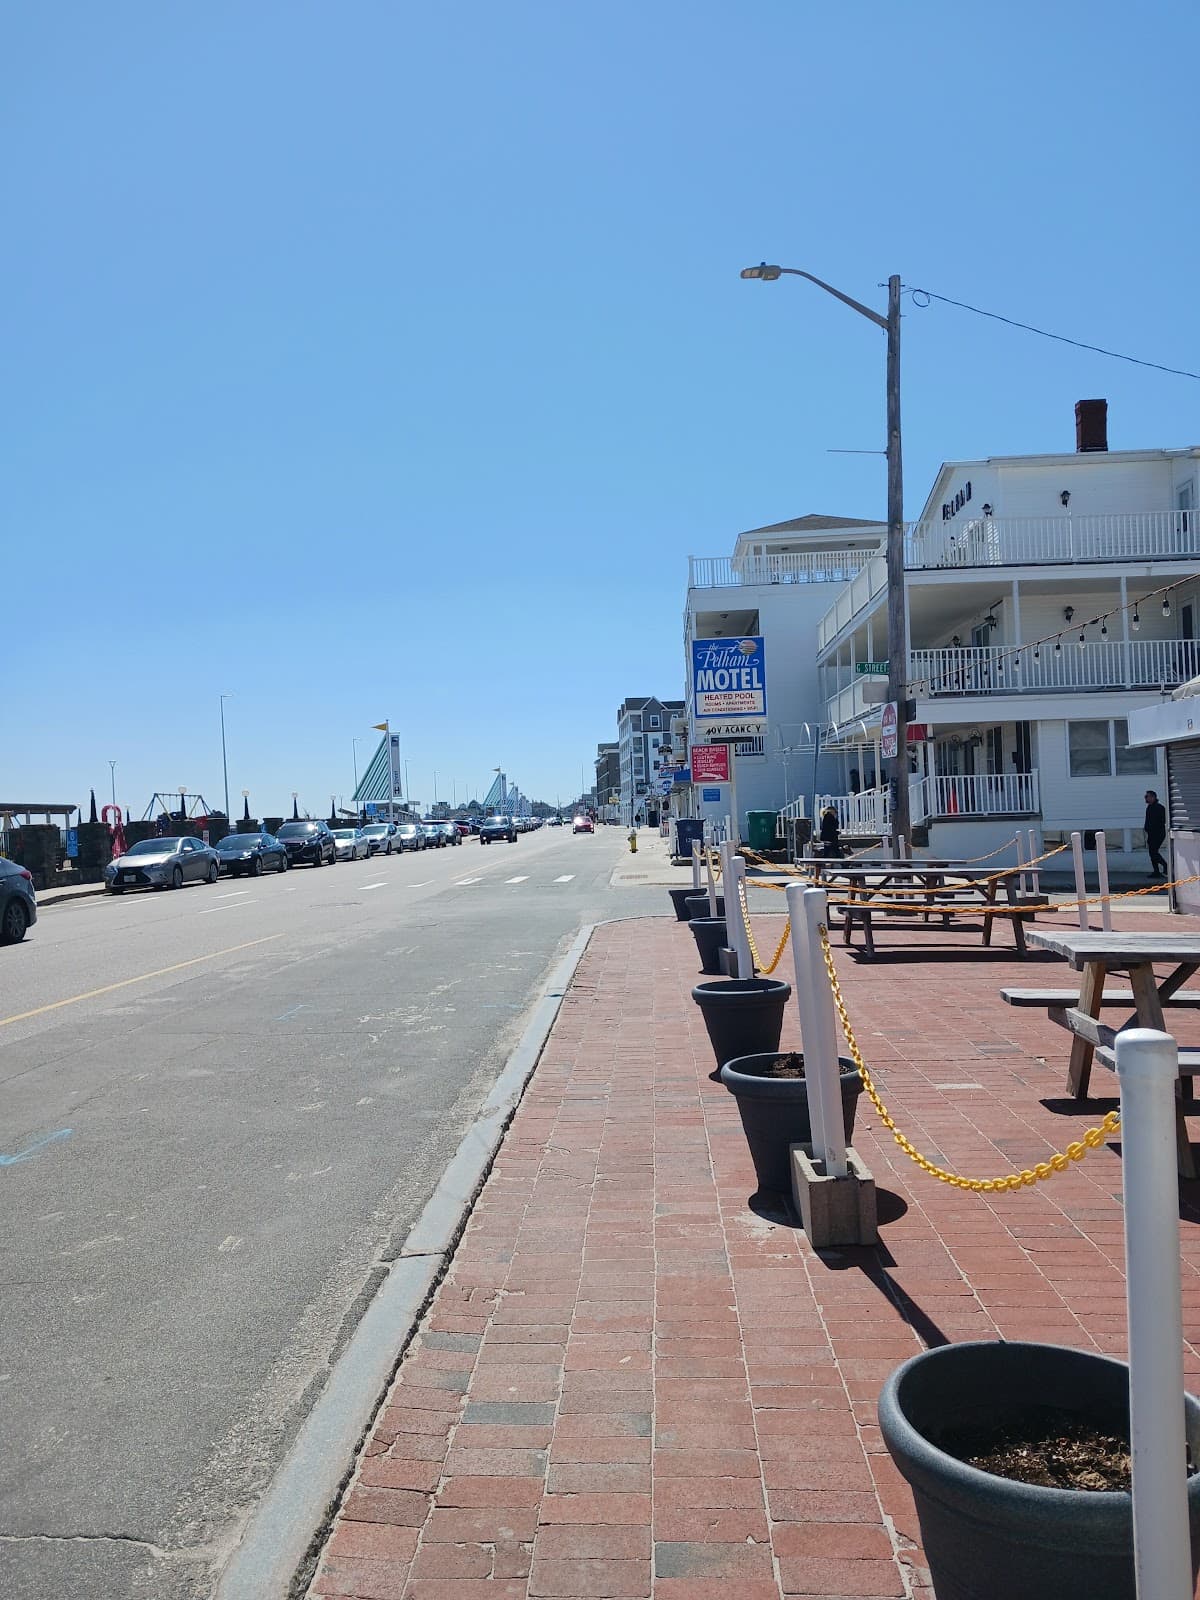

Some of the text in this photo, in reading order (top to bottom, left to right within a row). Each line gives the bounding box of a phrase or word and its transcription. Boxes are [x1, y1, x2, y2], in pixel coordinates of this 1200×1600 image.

[697, 650, 760, 668] Pelham
[864, 663, 887, 673] STREET
[697, 667, 763, 691] MOTEL
[704, 692, 756, 701] HEATED POOL
